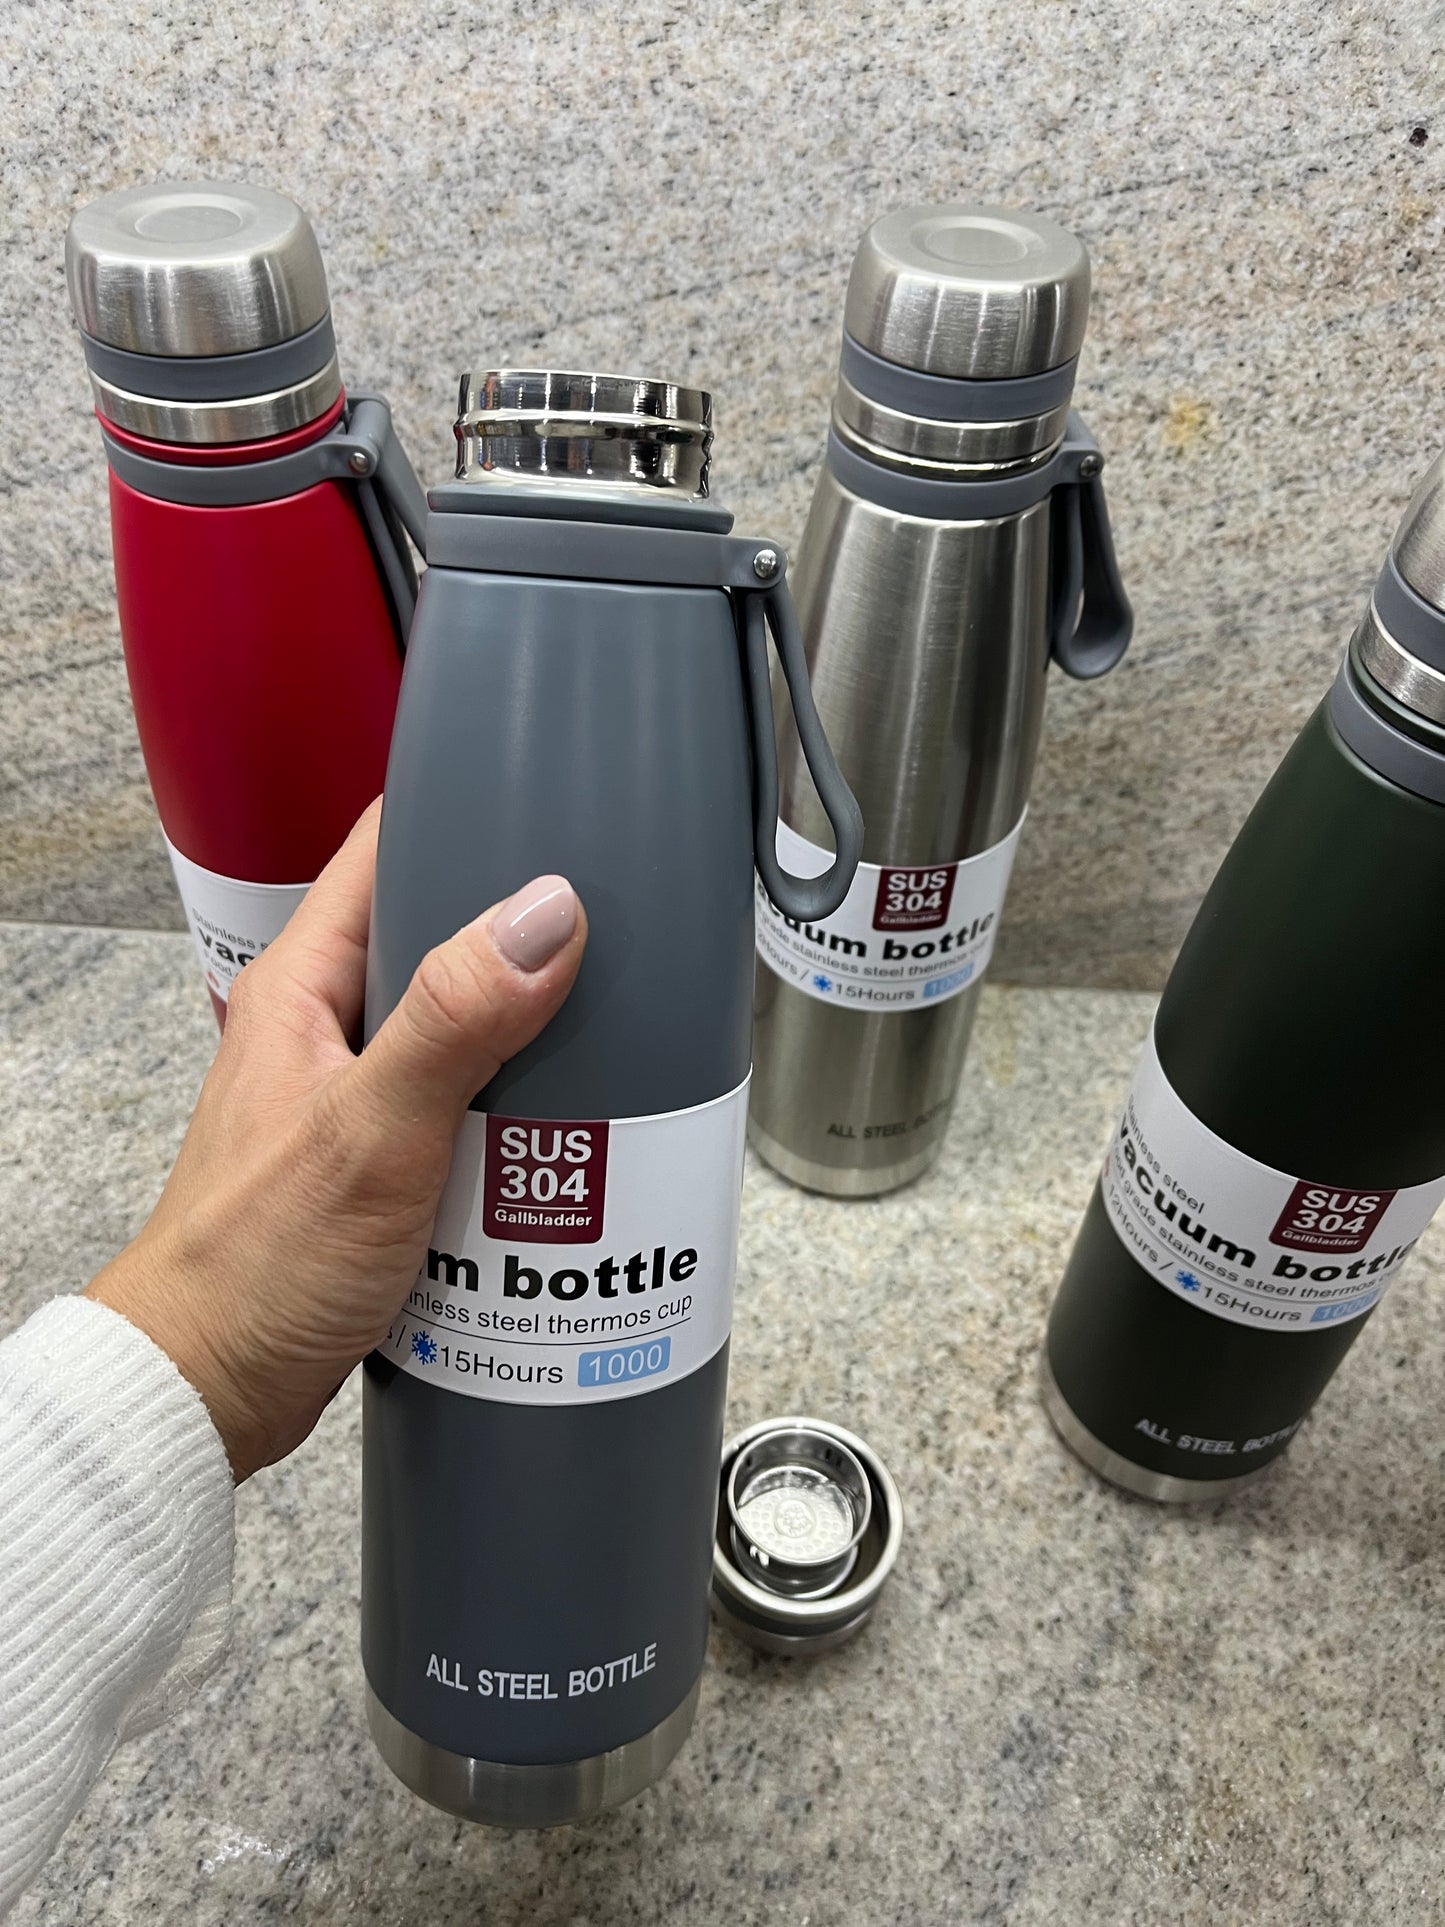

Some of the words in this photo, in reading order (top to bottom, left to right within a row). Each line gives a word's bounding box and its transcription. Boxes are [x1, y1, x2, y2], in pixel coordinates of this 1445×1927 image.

[887, 870, 948, 892] SUS
[885, 891, 942, 912] 304
[197, 926, 255, 967] vac
[882, 912, 994, 960] bottle
[792, 940, 858, 974] stainless
[863, 966, 904, 977] steel
[834, 982, 915, 1001] 15Hours
[499, 1125, 592, 1164] SUS
[827, 1123, 857, 1139] ALL
[863, 1121, 906, 1140] STEEL
[499, 1165, 588, 1203] 304
[1120, 1112, 1257, 1269] vacuum
[1163, 1174, 1206, 1214] steel
[1301, 1189, 1380, 1215] SUS
[494, 1208, 592, 1227] Gallbladder
[1292, 1209, 1367, 1234] 304
[1281, 1229, 1361, 1247] Gallbladder
[503, 1246, 699, 1301] bottle
[1159, 1226, 1239, 1282] stainless
[1244, 1278, 1296, 1298] steel
[1300, 1278, 1376, 1299] thermos
[477, 1311, 539, 1335] steel
[548, 1306, 651, 1335] thermos
[657, 1294, 692, 1319] cup
[1204, 1286, 1302, 1321] 15Hours
[440, 1345, 564, 1385] 15Hours
[588, 1344, 663, 1382] 1000
[1135, 1417, 1172, 1445] ALL
[1176, 1434, 1236, 1455] STEEL
[426, 1653, 469, 1691] ALL
[477, 1669, 558, 1700] STEEL
[568, 1642, 657, 1697] BOTTLE
